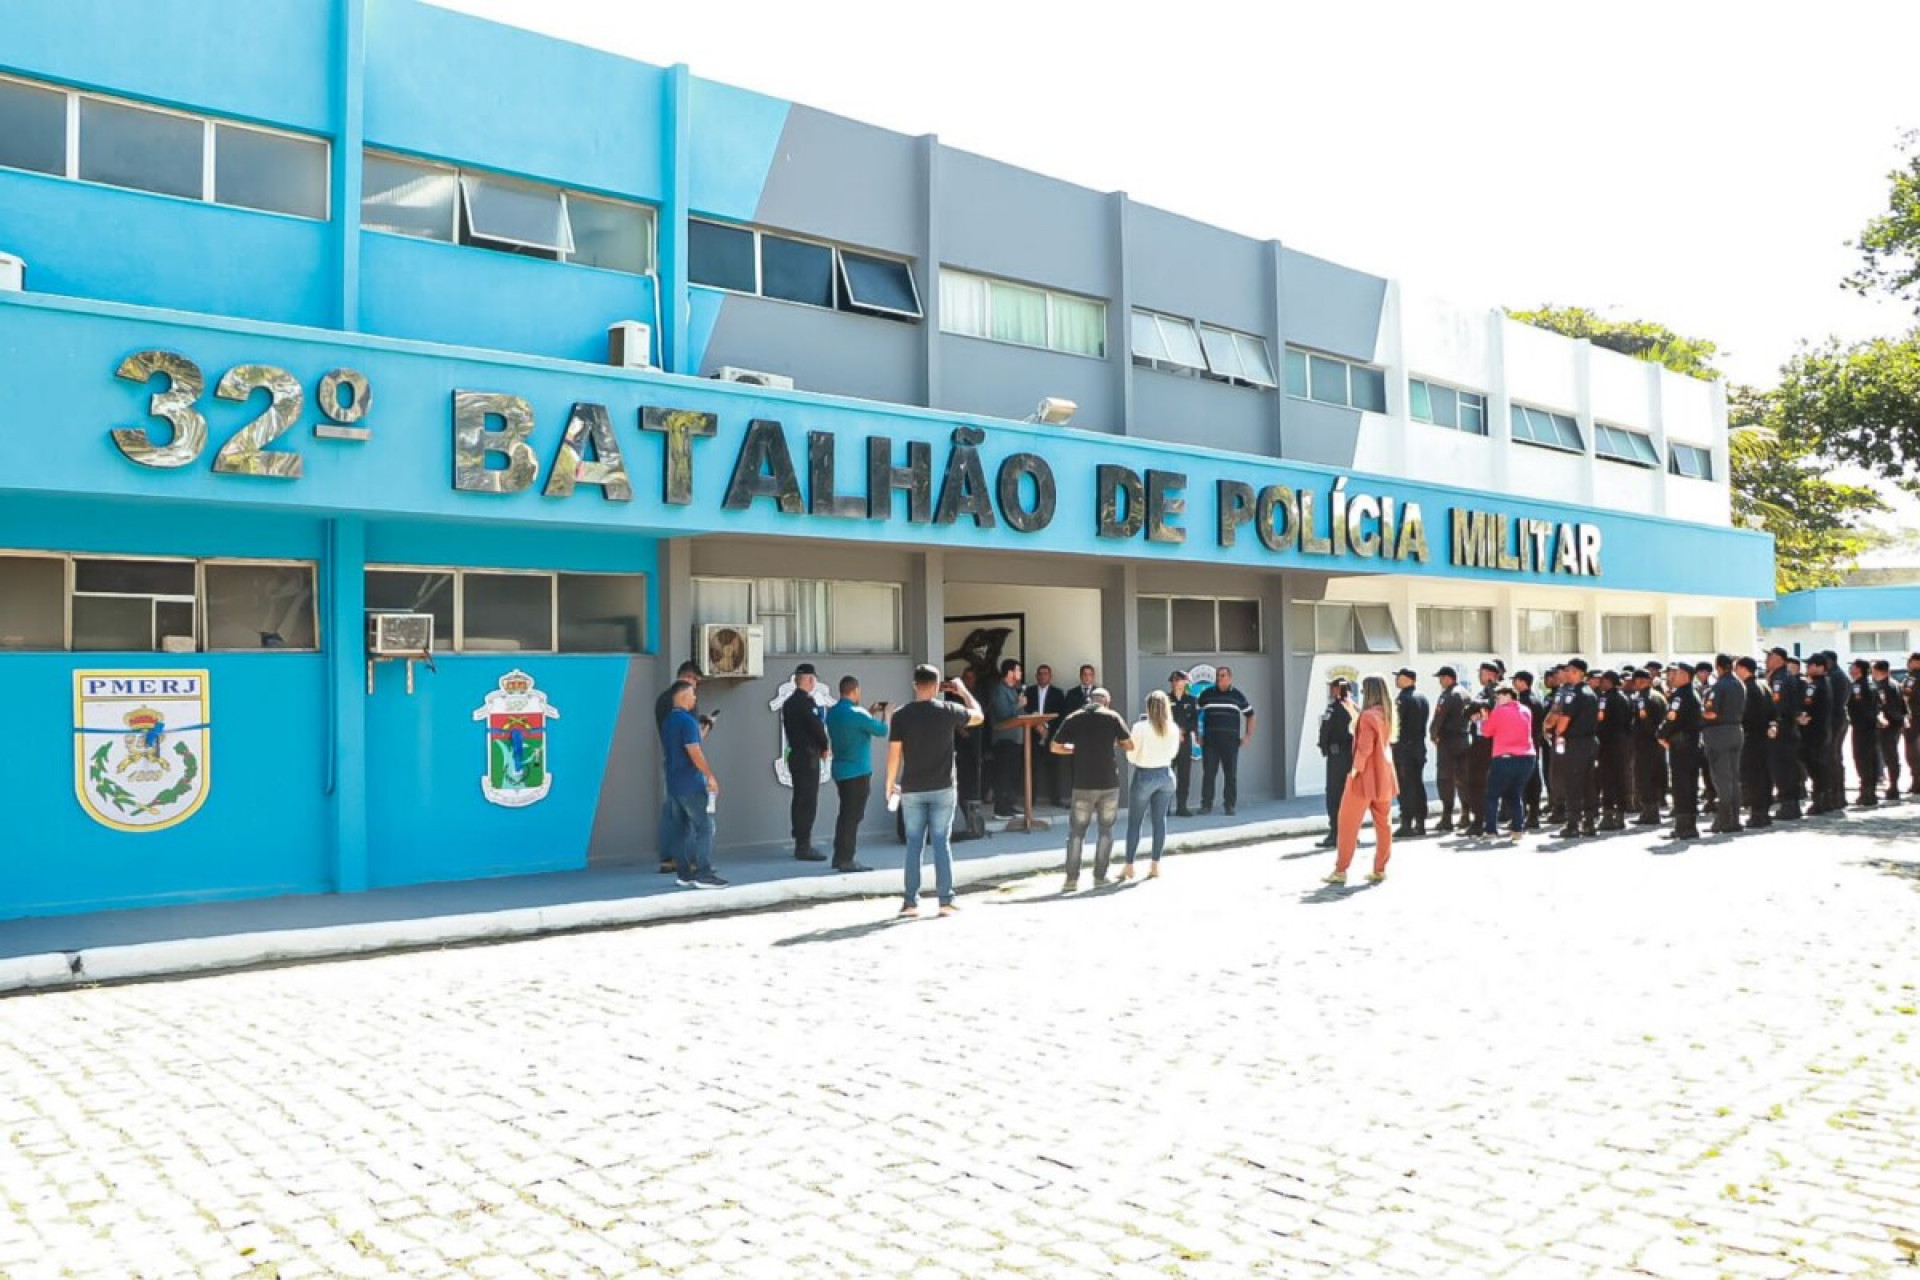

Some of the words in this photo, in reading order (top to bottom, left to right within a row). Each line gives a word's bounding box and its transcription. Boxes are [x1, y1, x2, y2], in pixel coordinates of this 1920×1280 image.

[452, 388, 1057, 533] BATALHÃO
[1096, 464, 1188, 543] DE
[1216, 477, 1430, 562] POLÍCIA
[1450, 507, 1602, 576] MILITAR
[88, 679, 196, 694] PMERJ
